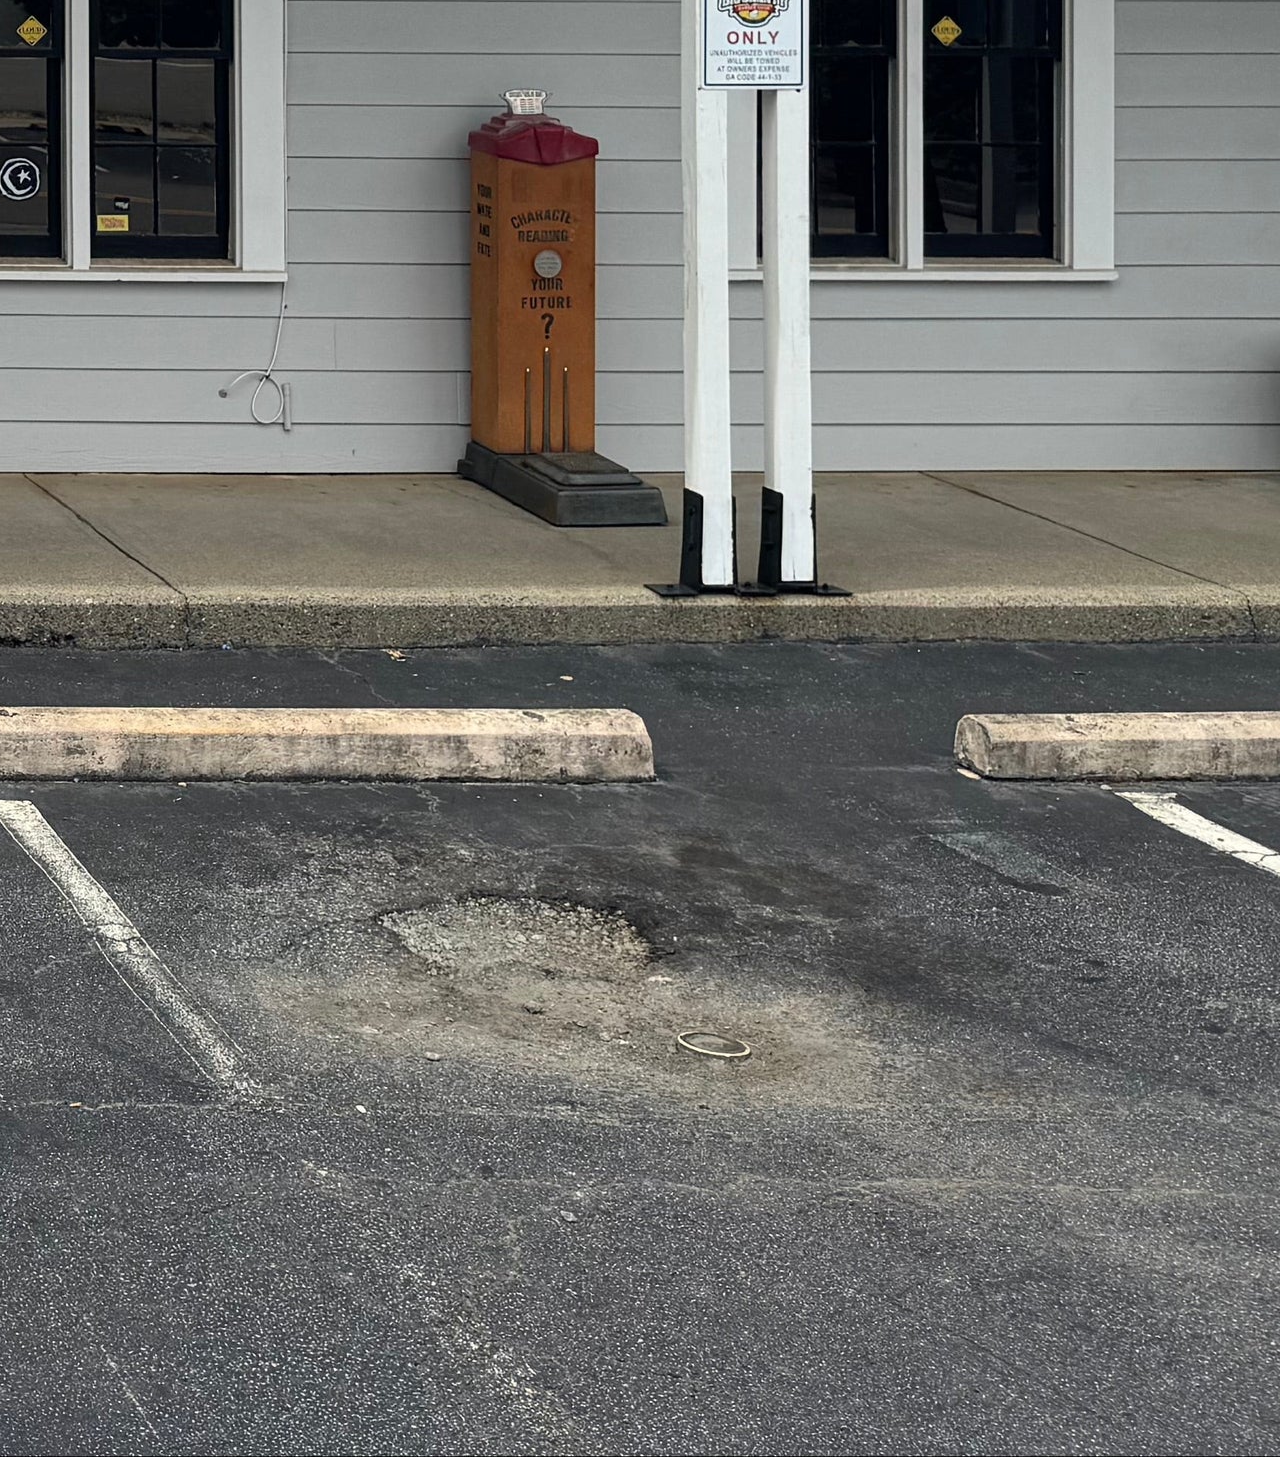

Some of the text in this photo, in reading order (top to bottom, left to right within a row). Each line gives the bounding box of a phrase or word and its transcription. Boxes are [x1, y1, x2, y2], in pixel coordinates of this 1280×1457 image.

[727, 31, 779, 45] ONLY
[710, 49, 762, 57] UNAUTHORIZED
[518, 229, 569, 243] READING
[531, 278, 563, 291] YOUR
[521, 296, 573, 309] FUTURE
